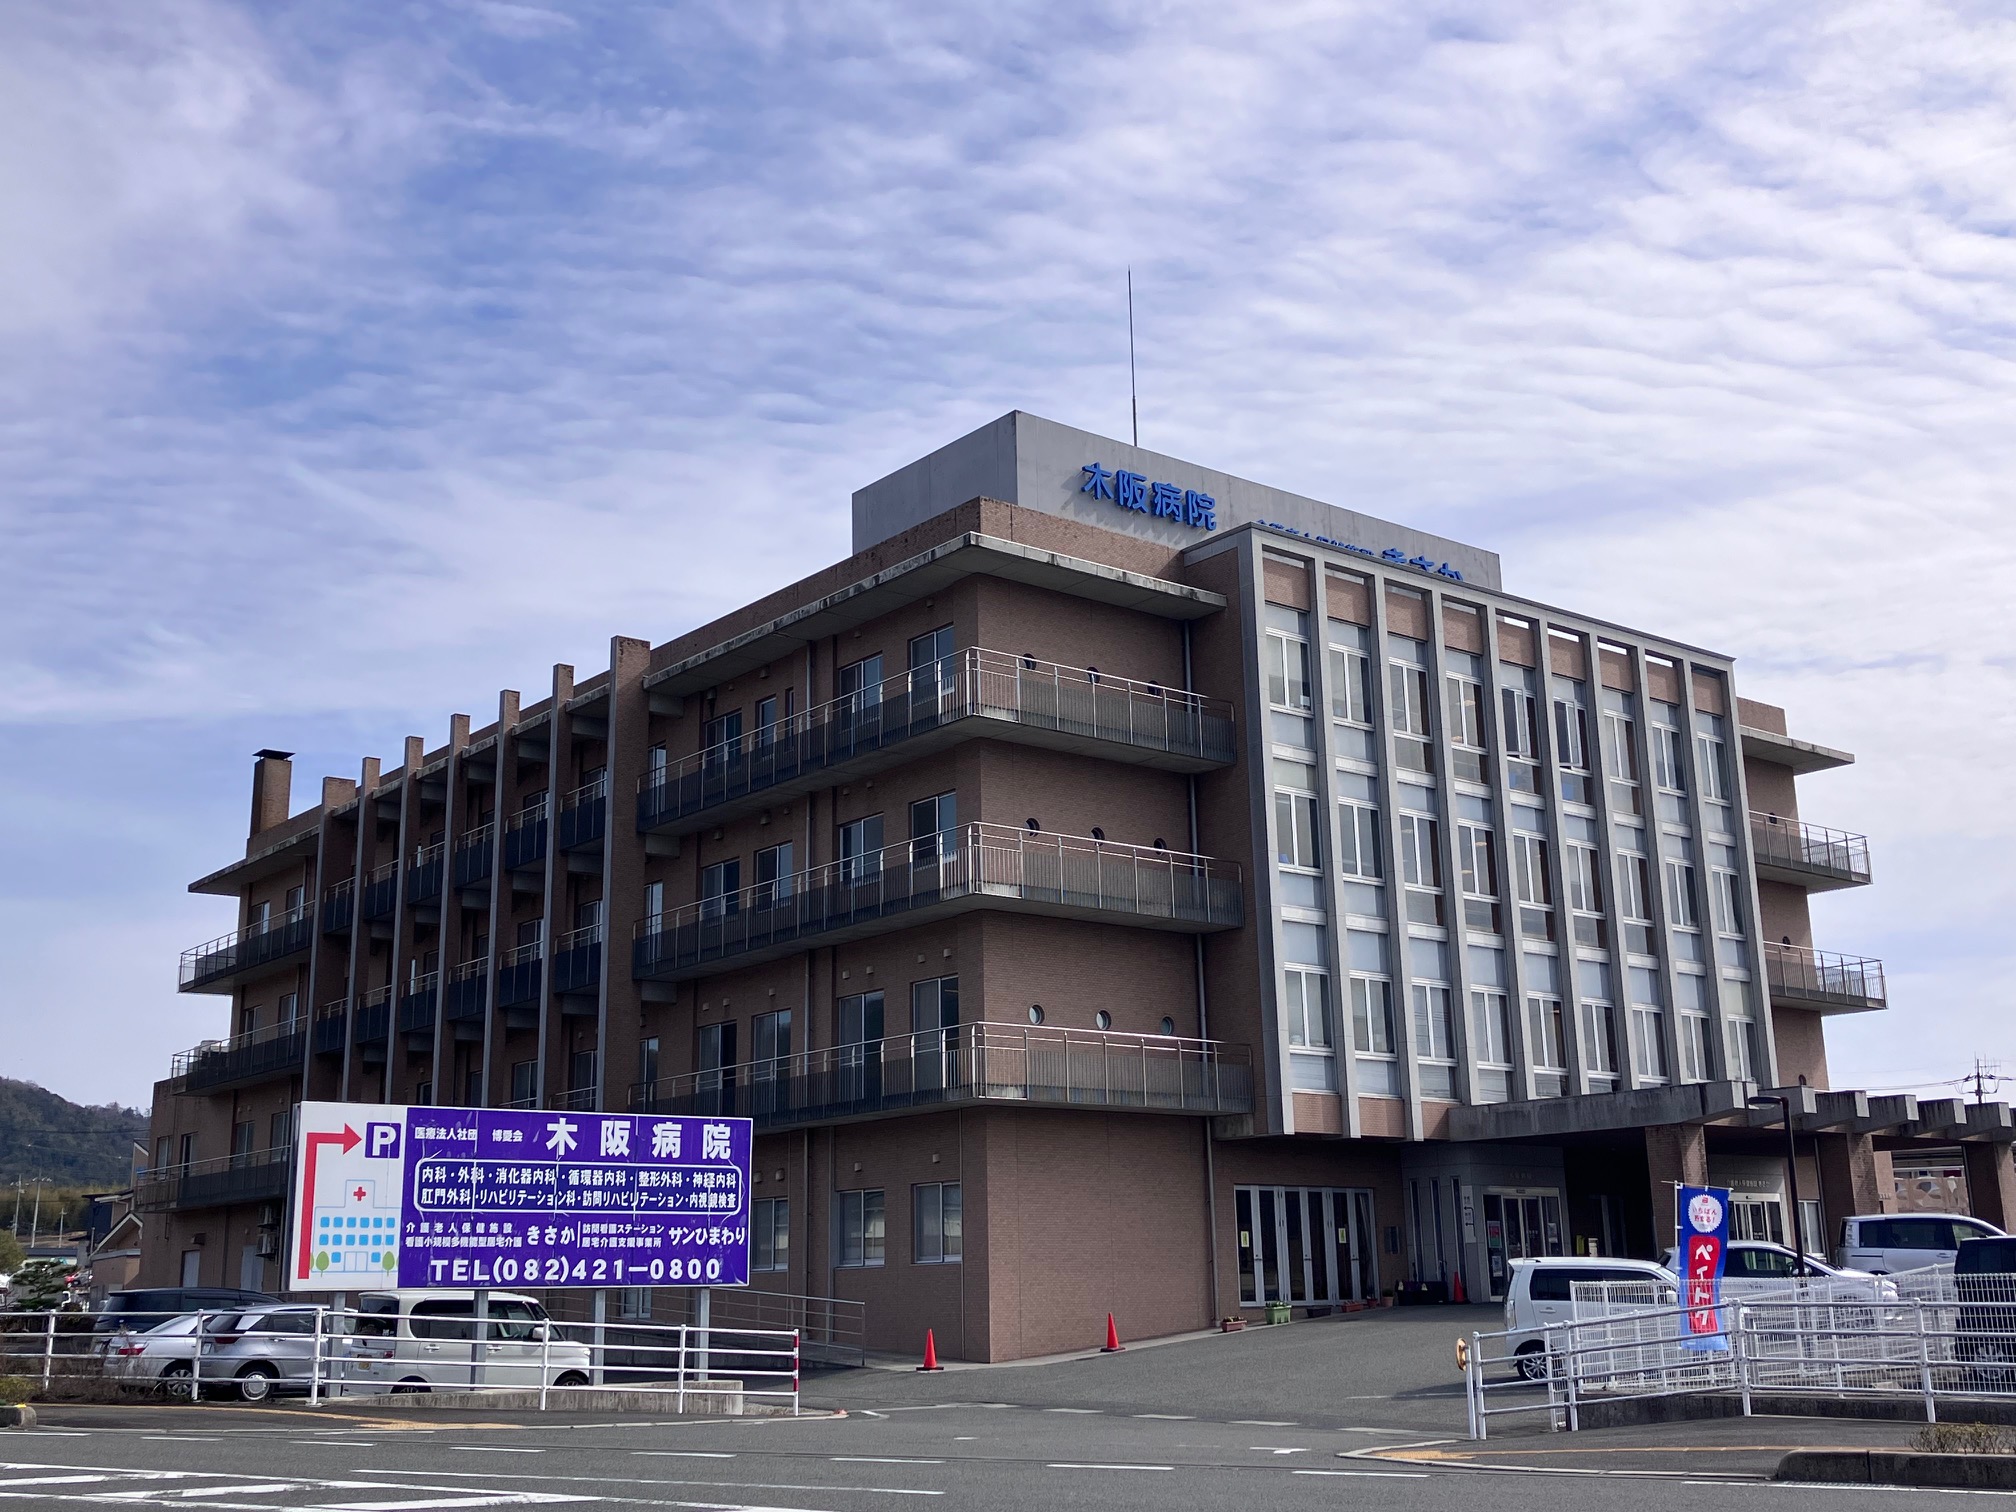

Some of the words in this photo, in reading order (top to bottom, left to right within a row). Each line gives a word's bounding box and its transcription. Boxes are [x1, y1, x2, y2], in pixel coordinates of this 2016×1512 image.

[1081, 462, 1217, 531] 木阪病院
[372, 1125, 396, 1156] P
[414, 1126, 478, 1141] 医療法人社団
[492, 1129, 524, 1143] 博愛会
[545, 1117, 732, 1159] 木阪病院
[526, 1225, 576, 1246] きさか
[582, 1223, 665, 1234] 訪問看護ステーション
[668, 1226, 746, 1247] サンひまわり
